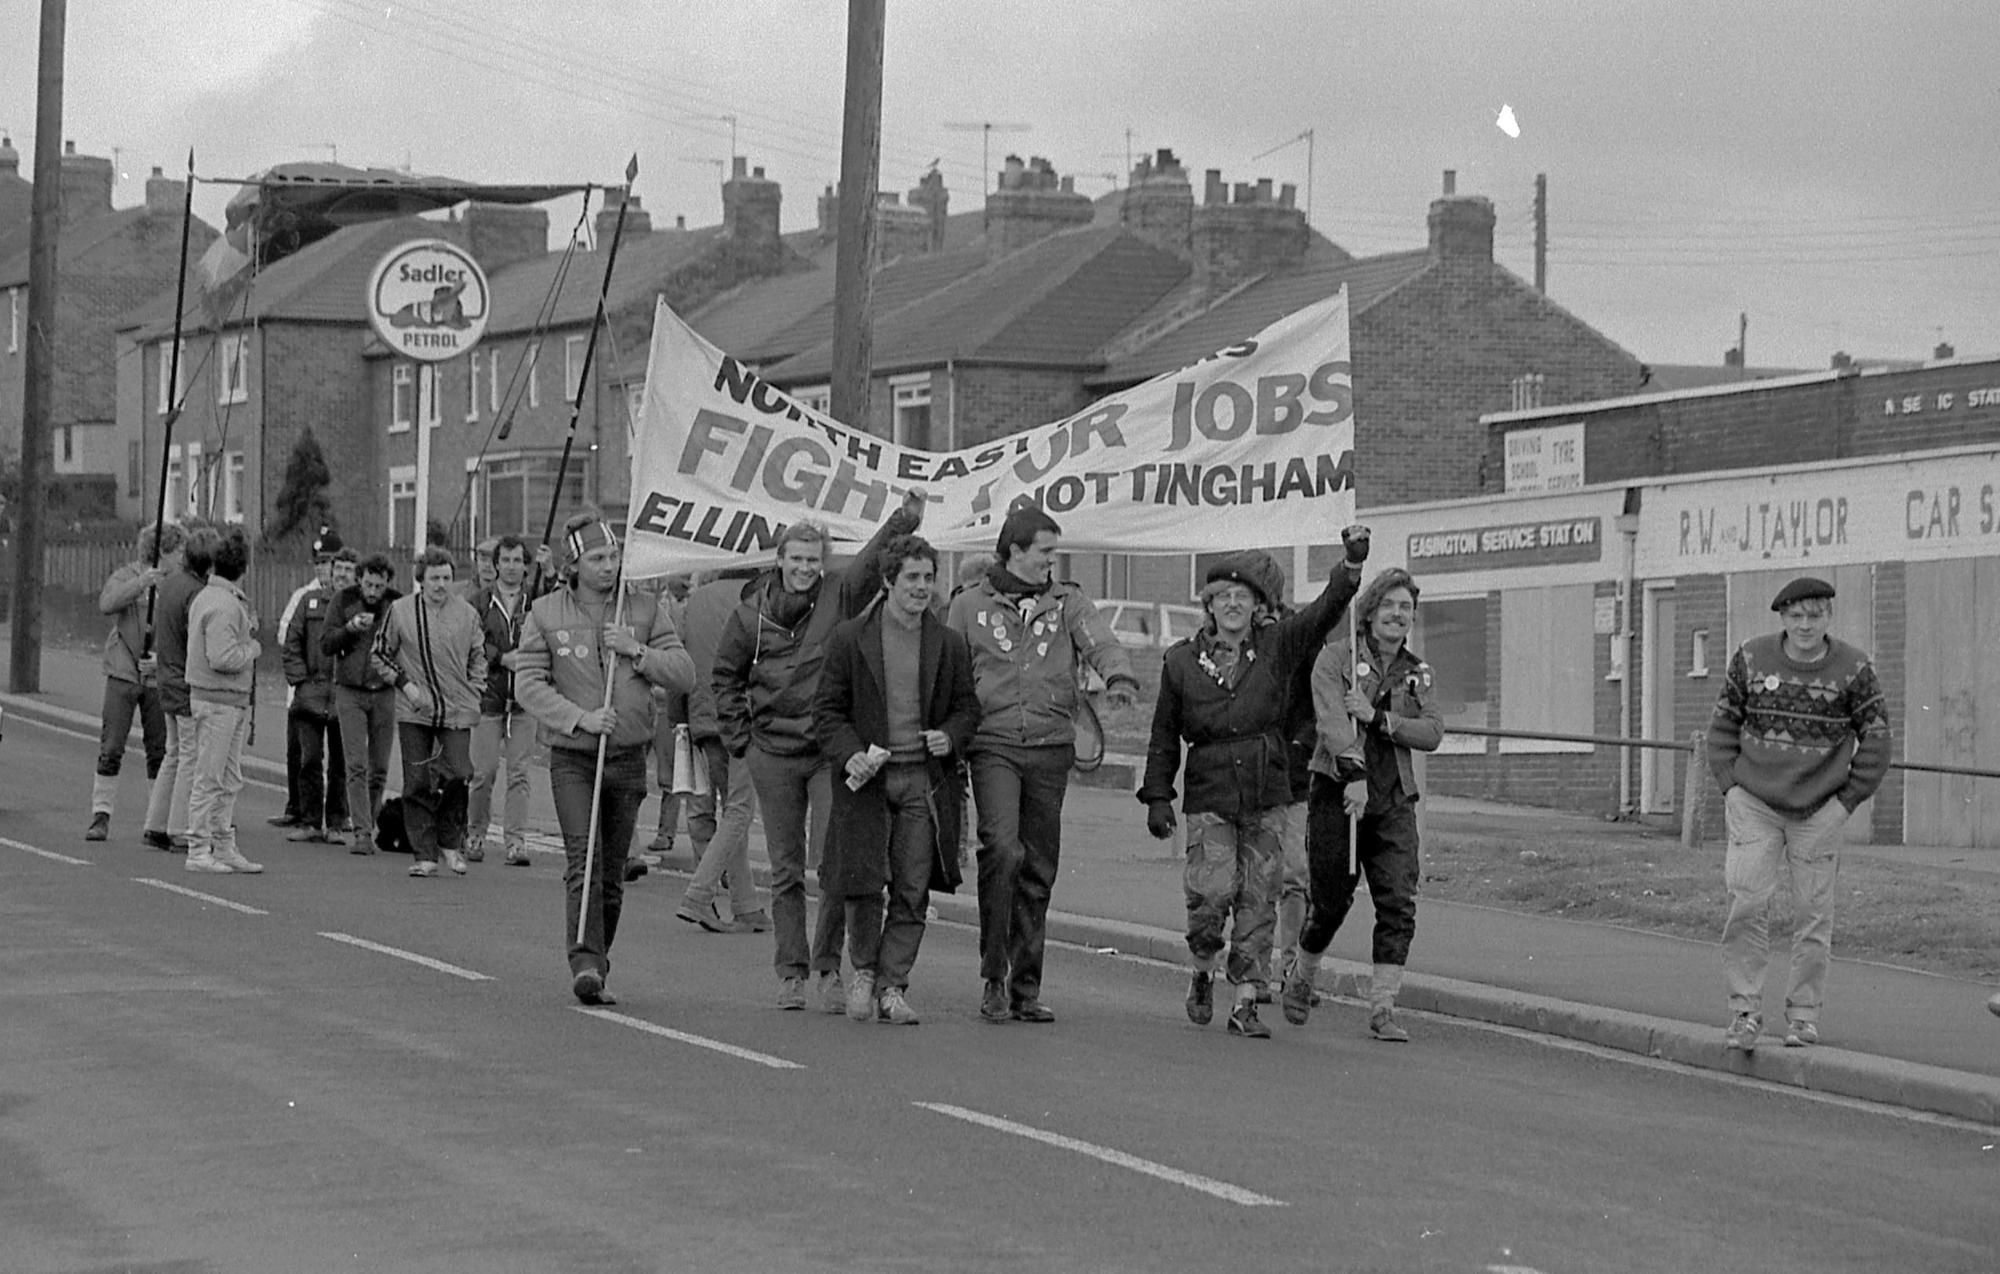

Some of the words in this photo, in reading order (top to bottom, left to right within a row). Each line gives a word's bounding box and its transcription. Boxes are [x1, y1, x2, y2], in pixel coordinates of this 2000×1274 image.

[400, 263, 466, 283] Sadler
[403, 332, 459, 348] PETROL
[1162, 360, 1354, 451] JOBS
[1007, 450, 1355, 515] NOTTINGHAM
[1906, 486, 1961, 539] CAR
[1410, 532, 1478, 558] EASINGTON
[1482, 527, 1536, 552] SERVICE
